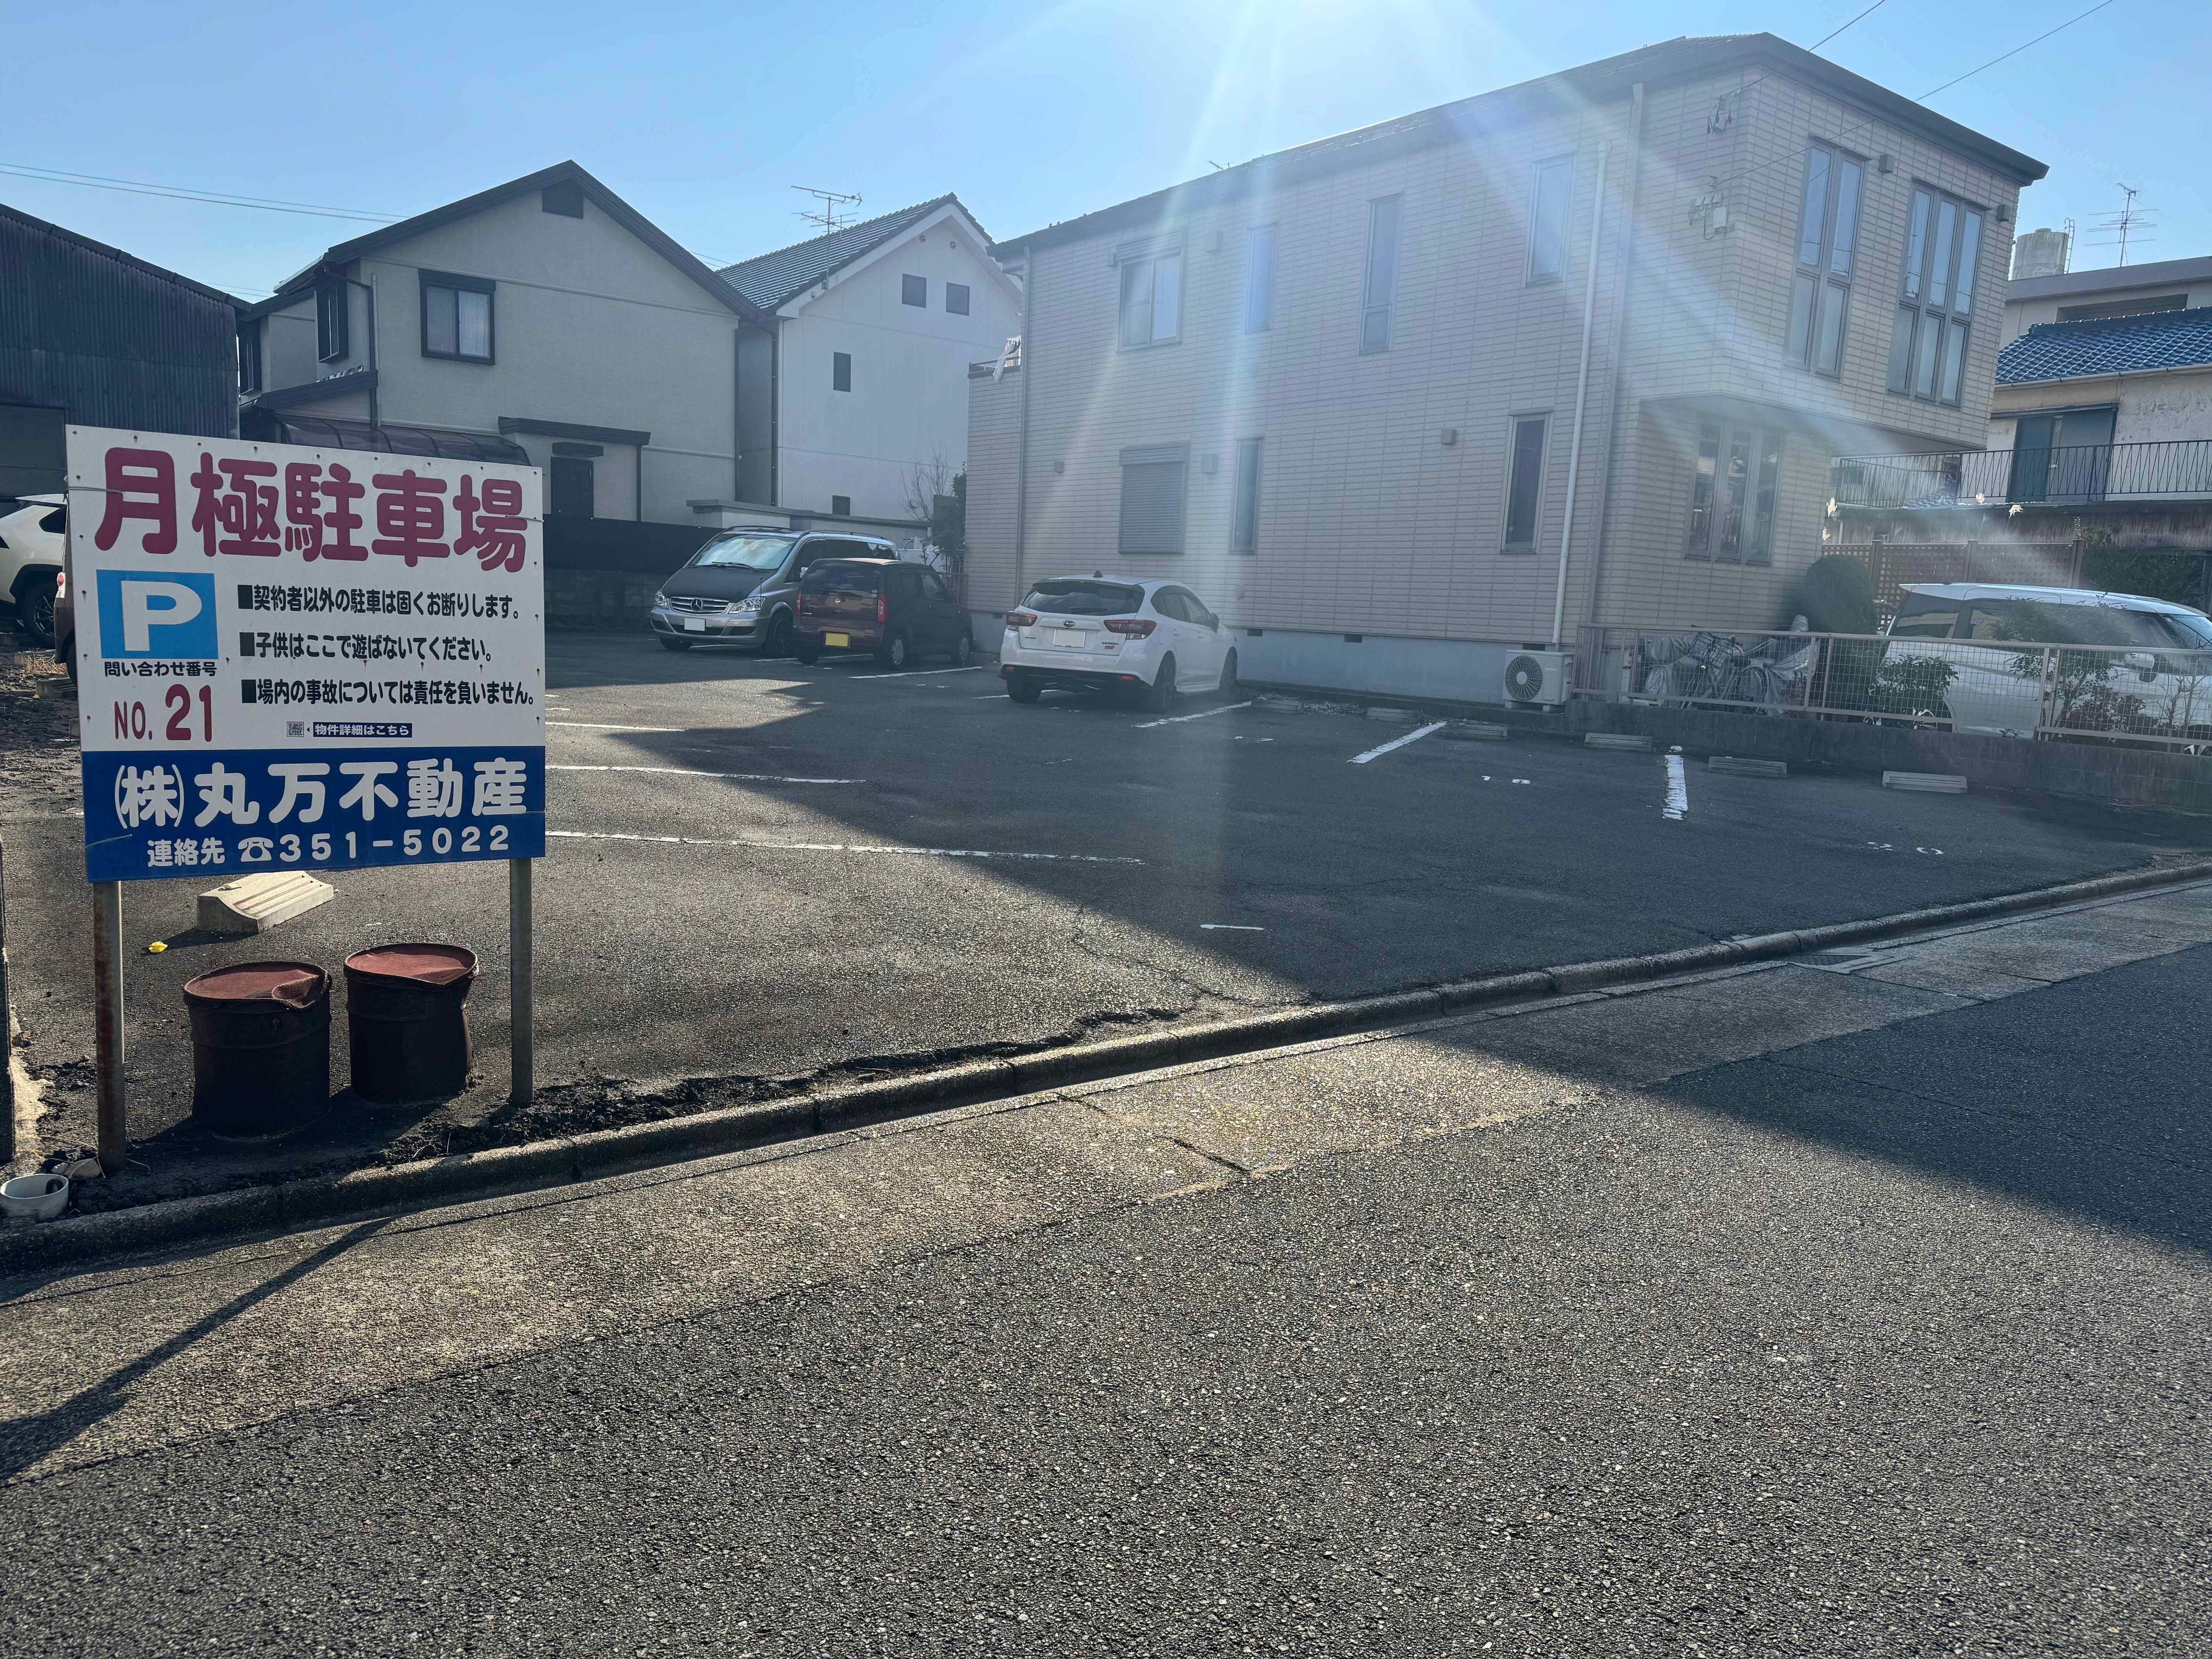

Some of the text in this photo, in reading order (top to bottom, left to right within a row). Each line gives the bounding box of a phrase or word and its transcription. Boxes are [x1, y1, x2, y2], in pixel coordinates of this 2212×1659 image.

[94, 447, 528, 573] 月極駐車場
[121, 581, 202, 652] P
[254, 585, 518, 619] 契約者以外の駐車は固くお断りします。
[105, 661, 217, 677] 問い合わせ番号
[257, 679, 533, 705] 場内の事故については責任を負いません。
[165, 684, 213, 743] 21
[315, 724, 410, 736] 物件詳細はこちら
[115, 757, 527, 829] (株)丸万不動産
[147, 836, 225, 868] 連絡先
